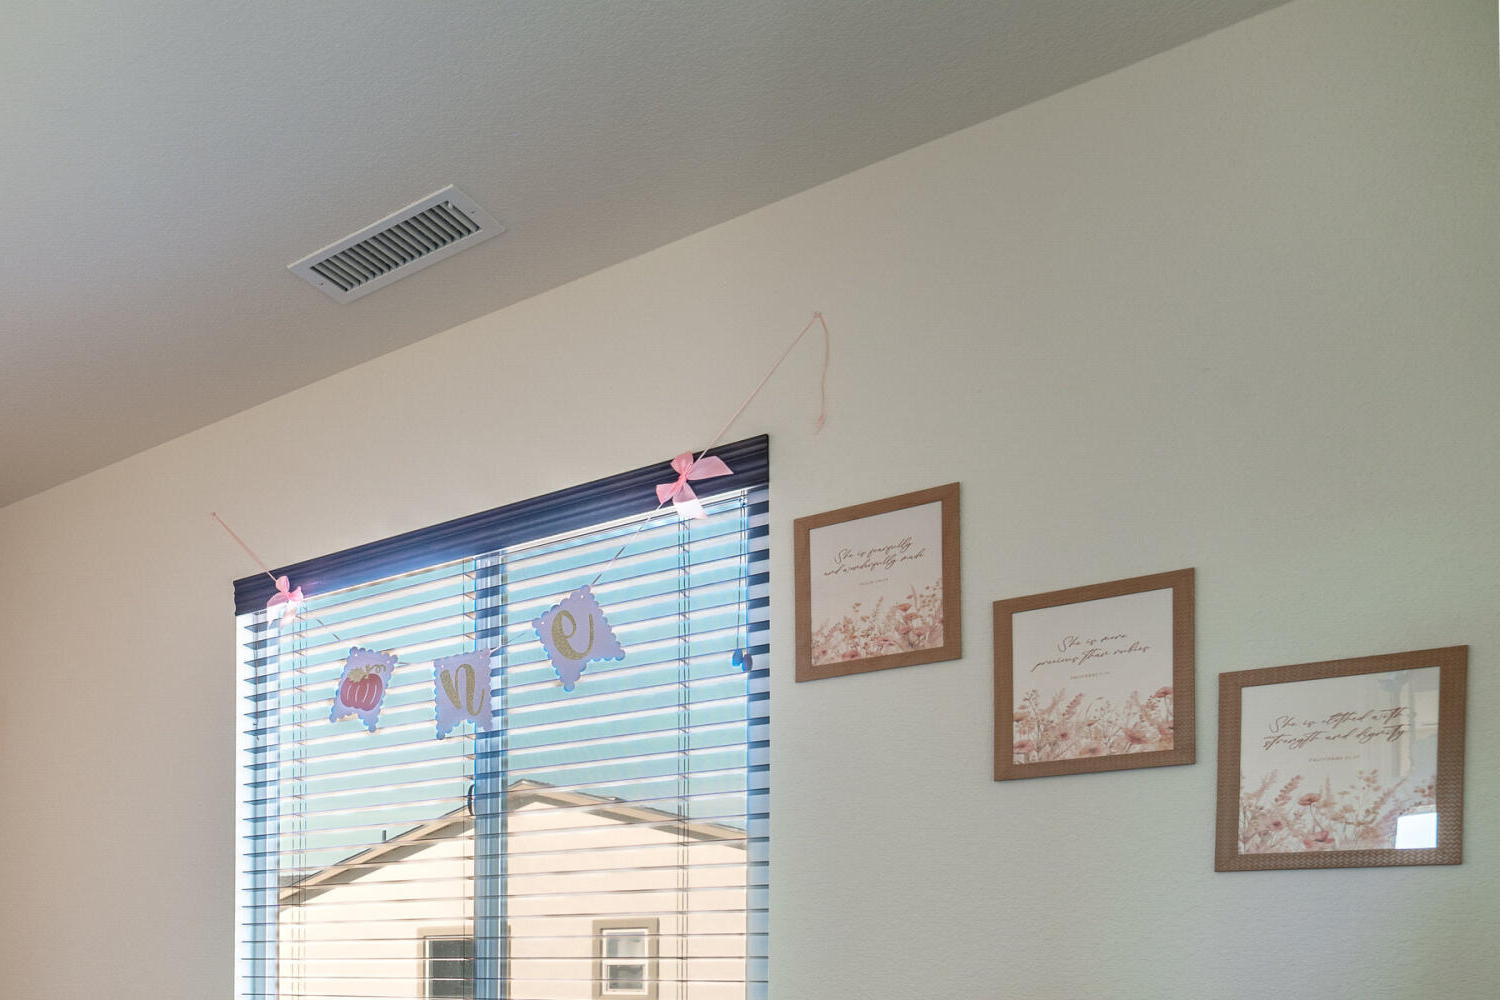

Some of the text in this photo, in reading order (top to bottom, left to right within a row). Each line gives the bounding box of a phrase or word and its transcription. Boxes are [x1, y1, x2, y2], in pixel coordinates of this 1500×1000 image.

[834, 547, 852, 565] She
[1057, 635, 1081, 653] She
[1268, 715, 1296, 733] She
[1322, 709, 1375, 729] clothed
[1371, 706, 1412, 725] with
[1263, 723, 1412, 751] strength and dignity
